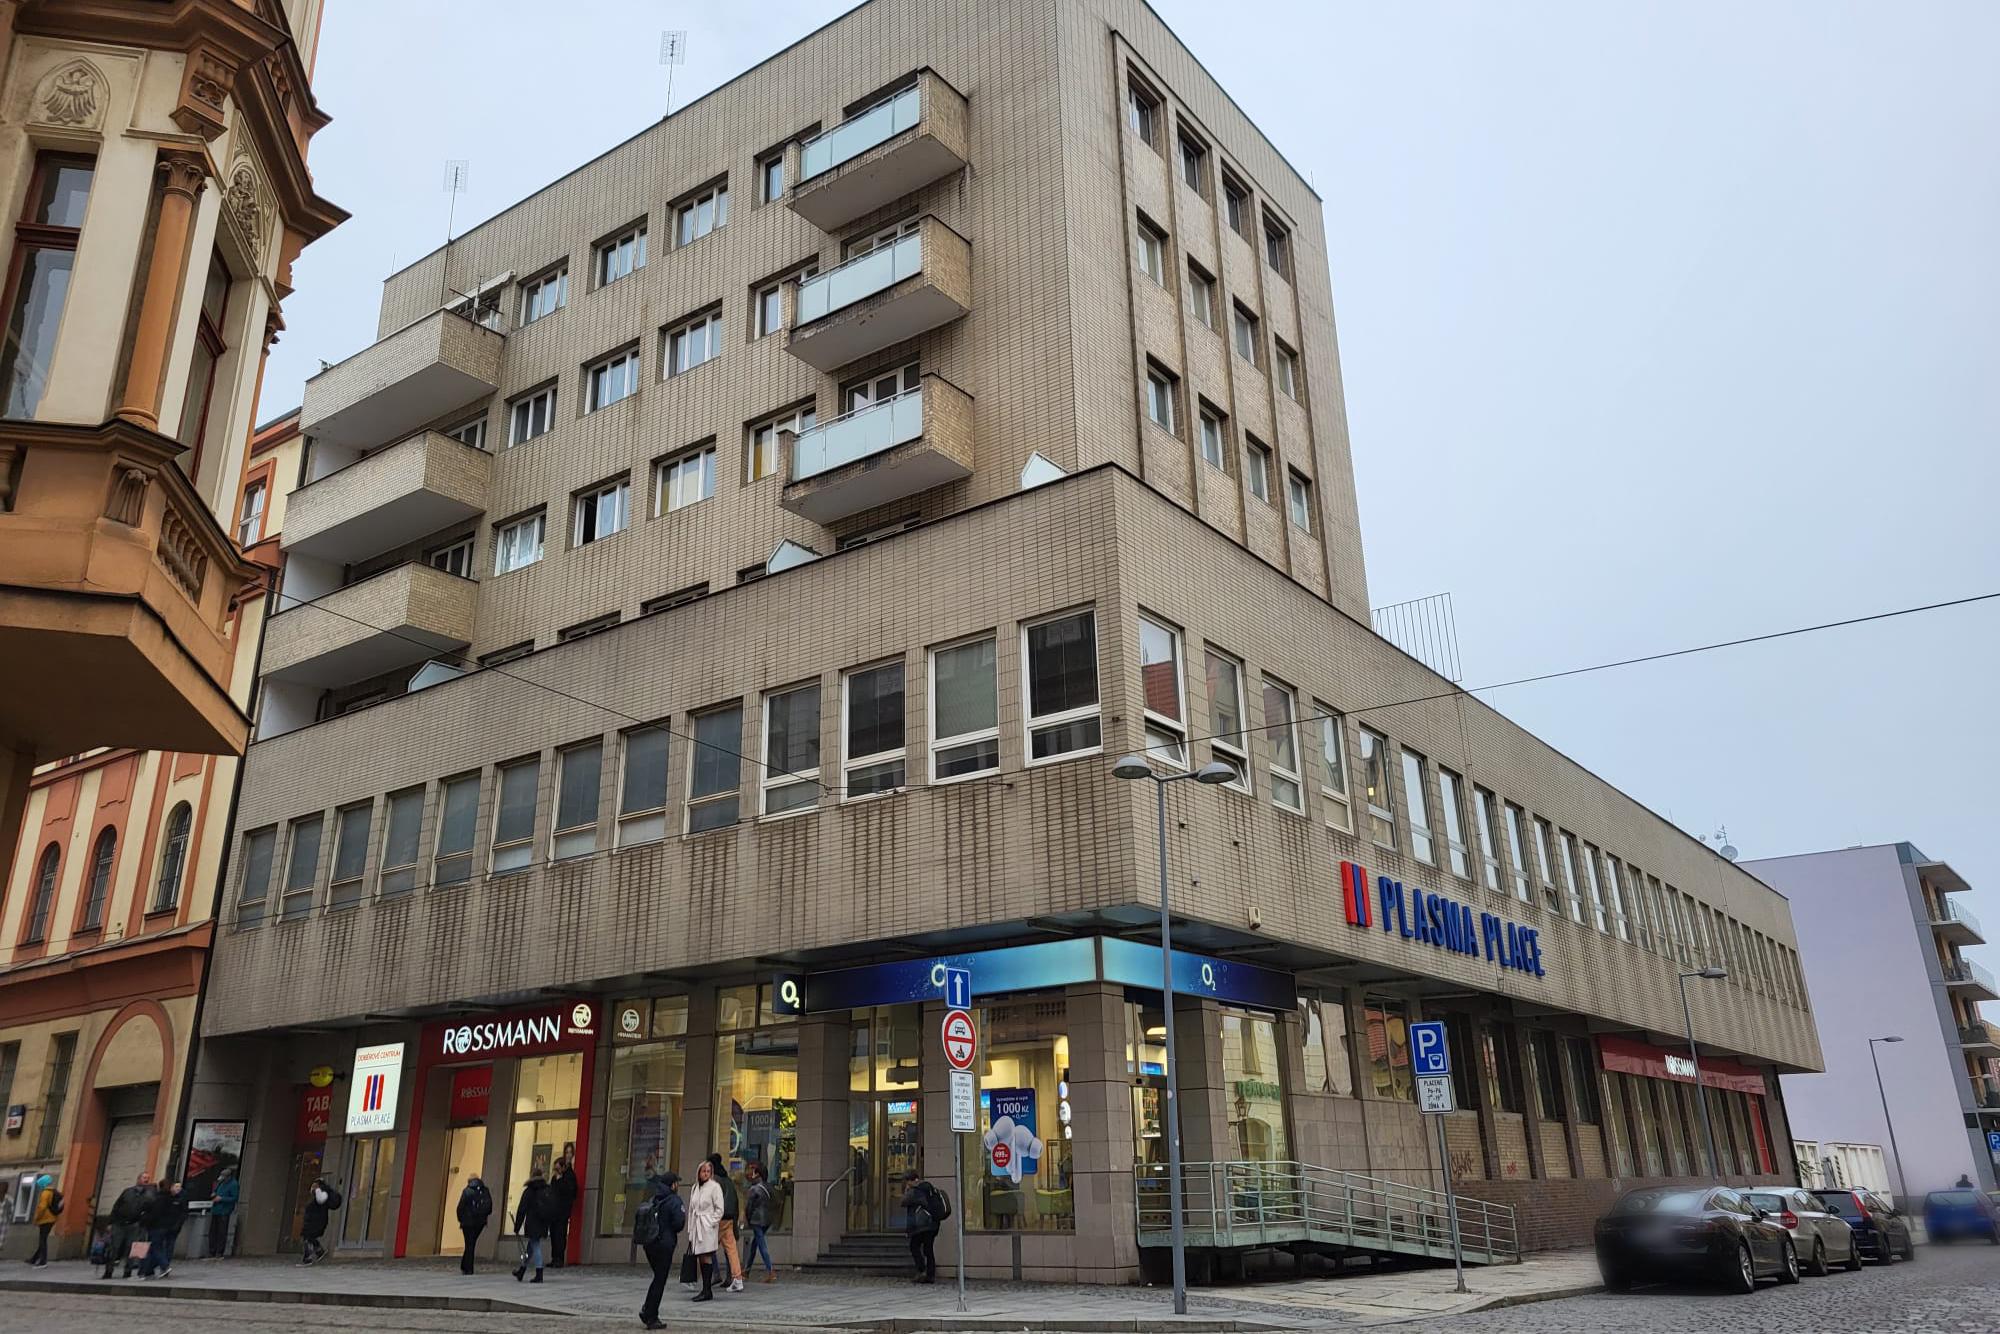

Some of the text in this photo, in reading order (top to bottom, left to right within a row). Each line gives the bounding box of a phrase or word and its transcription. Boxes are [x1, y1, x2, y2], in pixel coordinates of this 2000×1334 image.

[1378, 876, 1546, 977] PLASMA PLACE
[1202, 963, 1217, 991] O2
[781, 980, 800, 1009] O2
[443, 1015, 561, 1054] ROSSMANN
[1417, 1029, 1437, 1058] P
[351, 1113, 391, 1126] PLASMA PLACE
